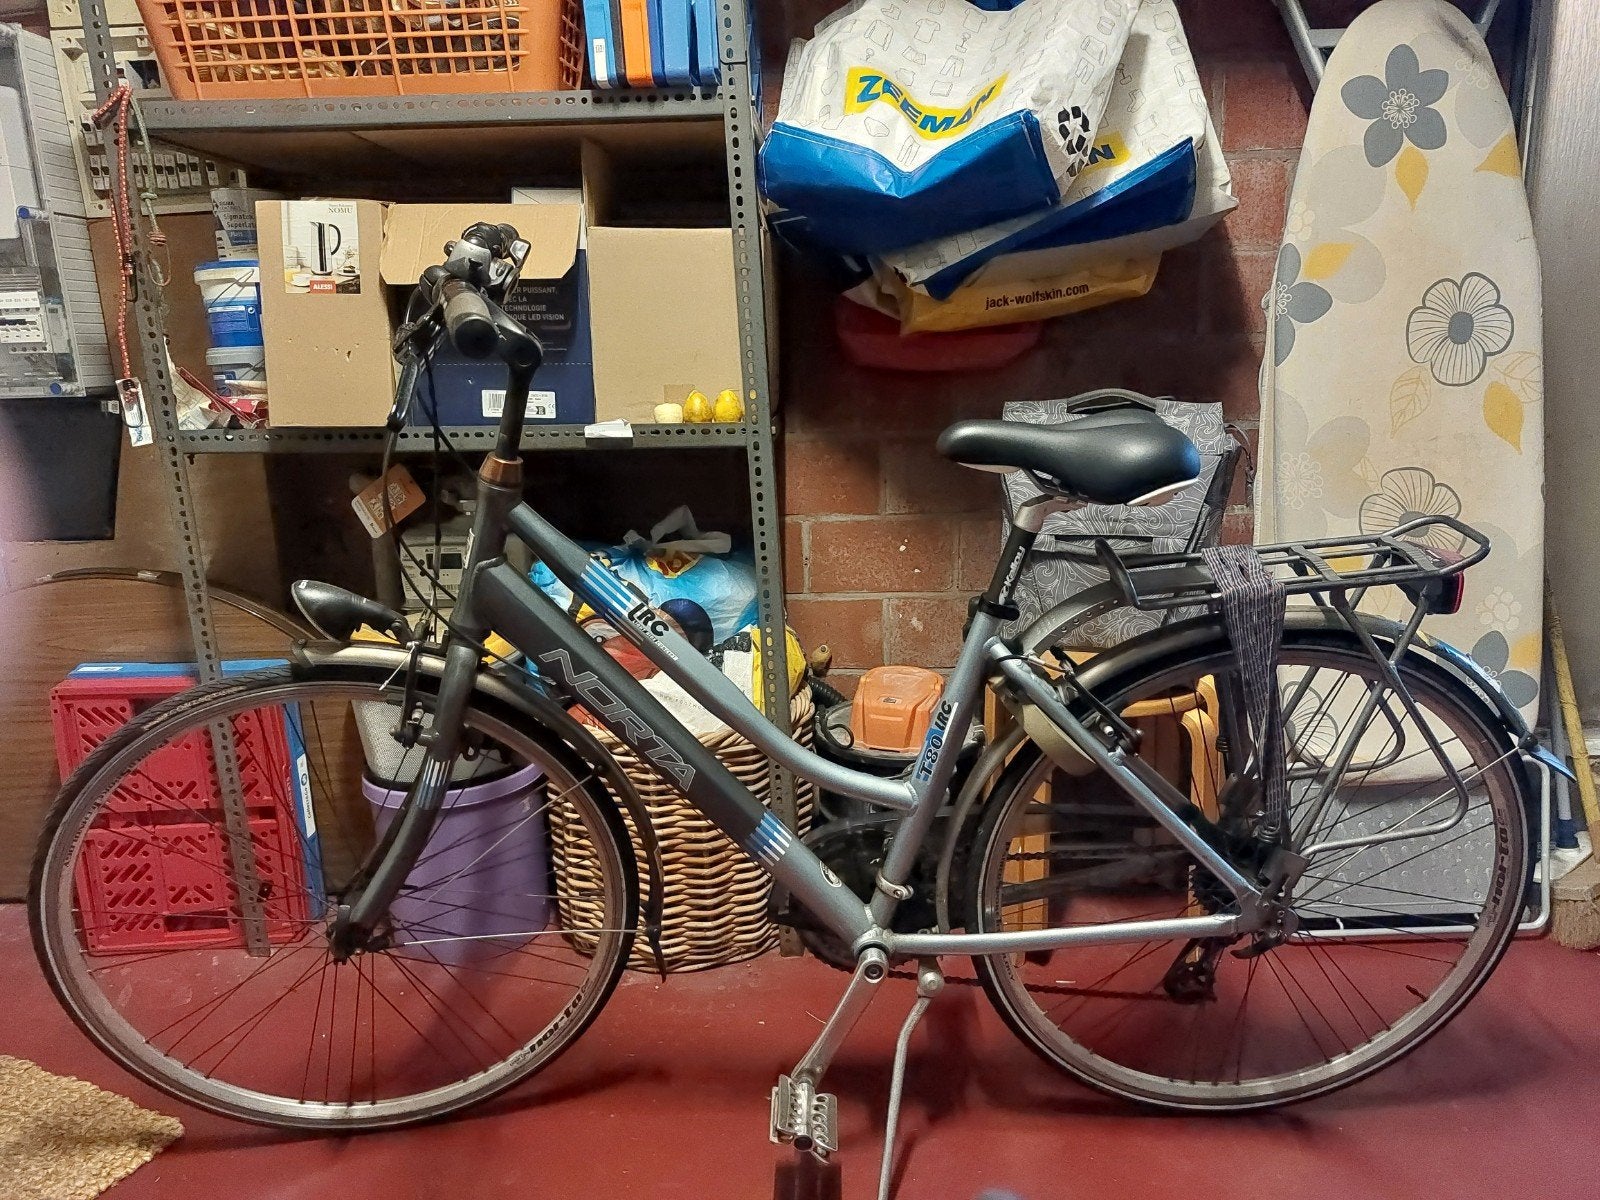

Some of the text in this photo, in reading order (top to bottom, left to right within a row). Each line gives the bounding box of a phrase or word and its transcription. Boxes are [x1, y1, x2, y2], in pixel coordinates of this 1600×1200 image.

[857, 75, 997, 133] ZEEMAN
[501, 304, 547, 312] TECHNOLOGIE
[985, 283, 1089, 310] jack-wolfskin.com
[627, 602, 670, 637] LRC
[538, 648, 697, 793] NORTA
[918, 733, 944, 777] T80
